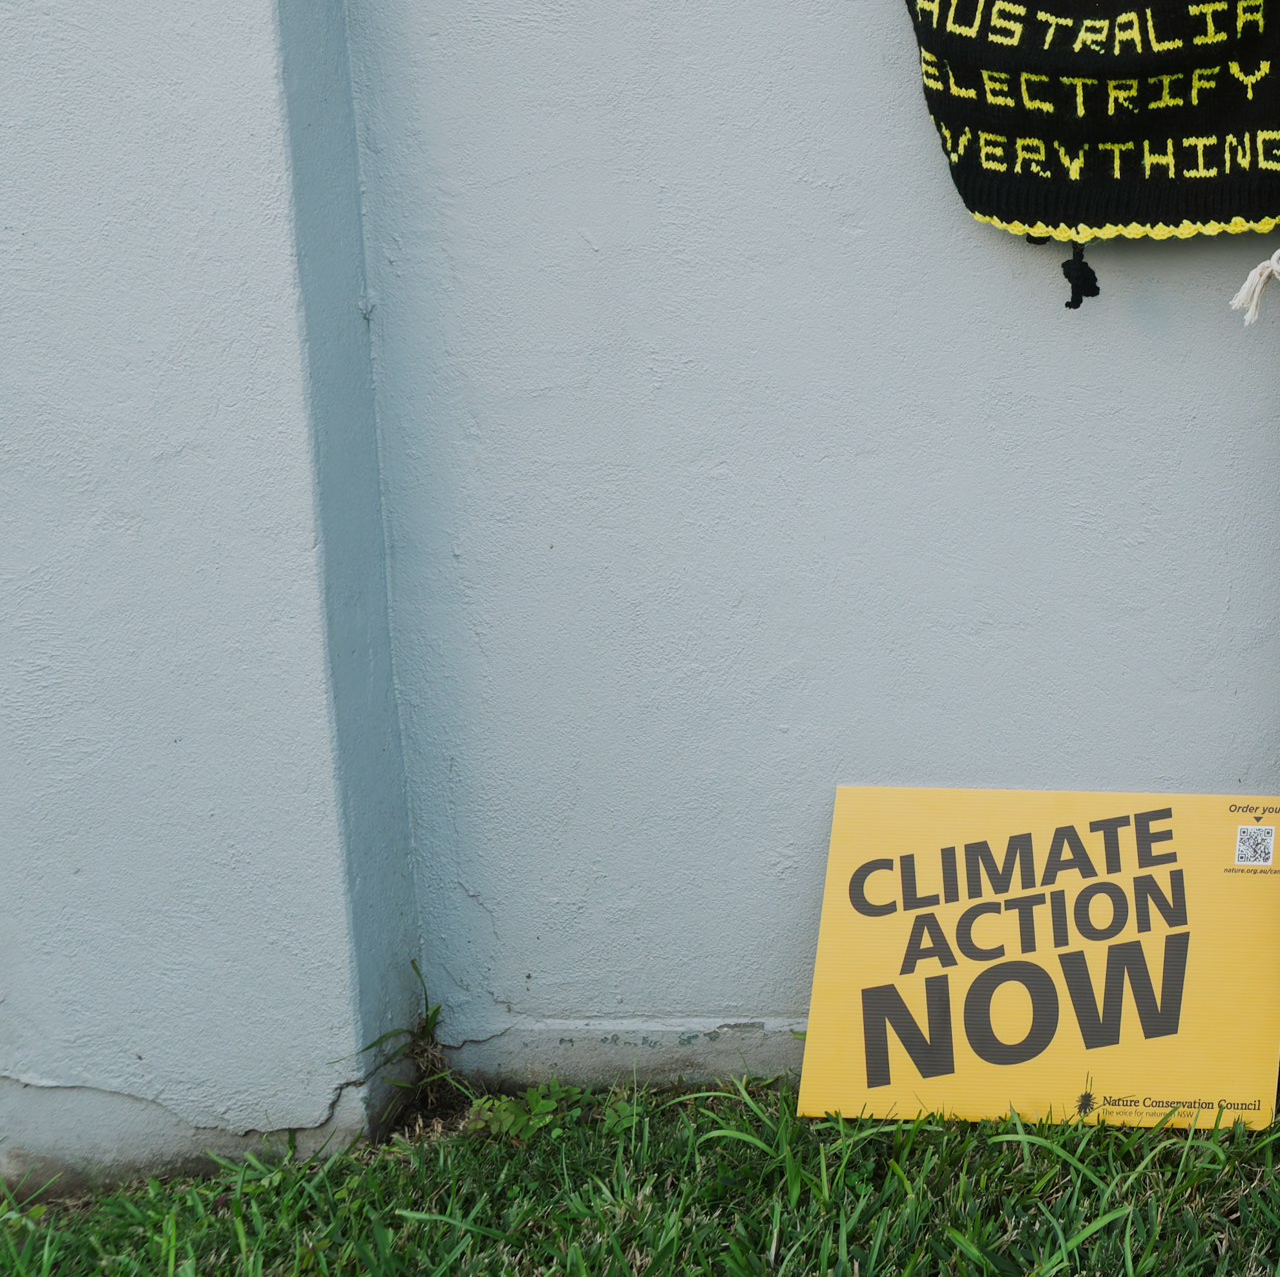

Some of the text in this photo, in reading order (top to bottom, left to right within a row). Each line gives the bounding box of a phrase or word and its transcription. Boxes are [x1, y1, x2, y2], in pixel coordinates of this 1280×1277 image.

[920, 47, 1271, 117] ELECTRIFY
[1229, 804, 1260, 813] Order
[848, 807, 1178, 918] CLIMATE
[899, 868, 1188, 976] ACTION
[861, 931, 1190, 1089] NOW
[1102, 1096, 1261, 1111] Nature Conservation Council
[1102, 1108, 1114, 1116] The
[1115, 1109, 1133, 1117] voice
[1134, 1109, 1143, 1117] for
